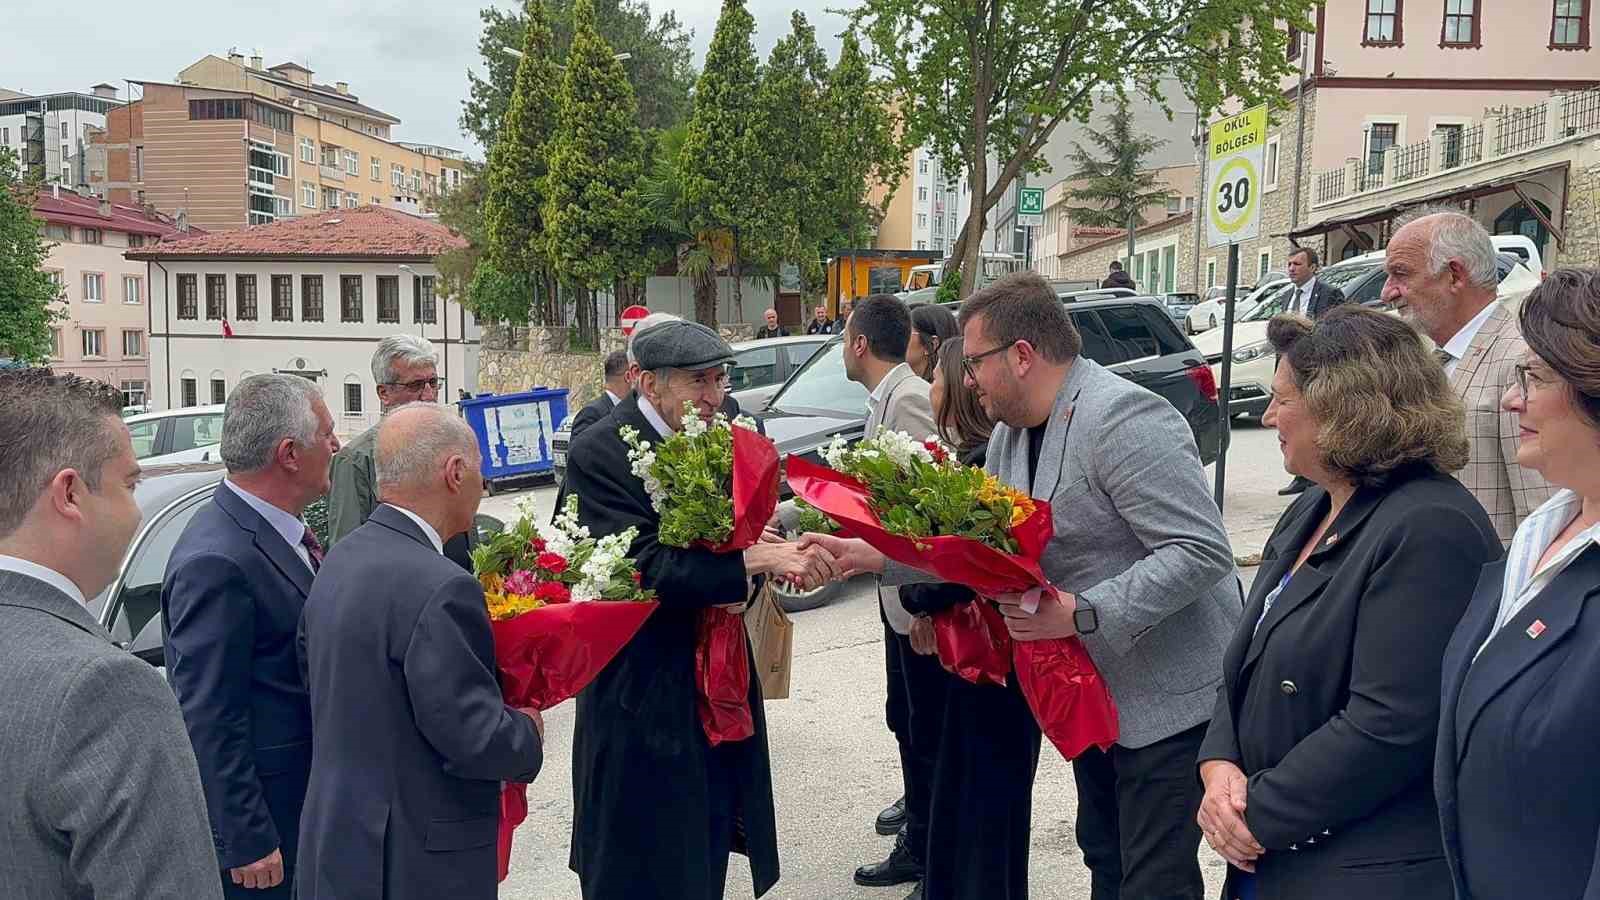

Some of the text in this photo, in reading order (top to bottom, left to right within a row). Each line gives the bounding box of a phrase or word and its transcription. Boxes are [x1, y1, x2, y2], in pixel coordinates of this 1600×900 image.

[1224, 115, 1251, 133] OKUL
[1216, 130, 1258, 154] BÖLGESİ
[1218, 177, 1249, 213] 30
